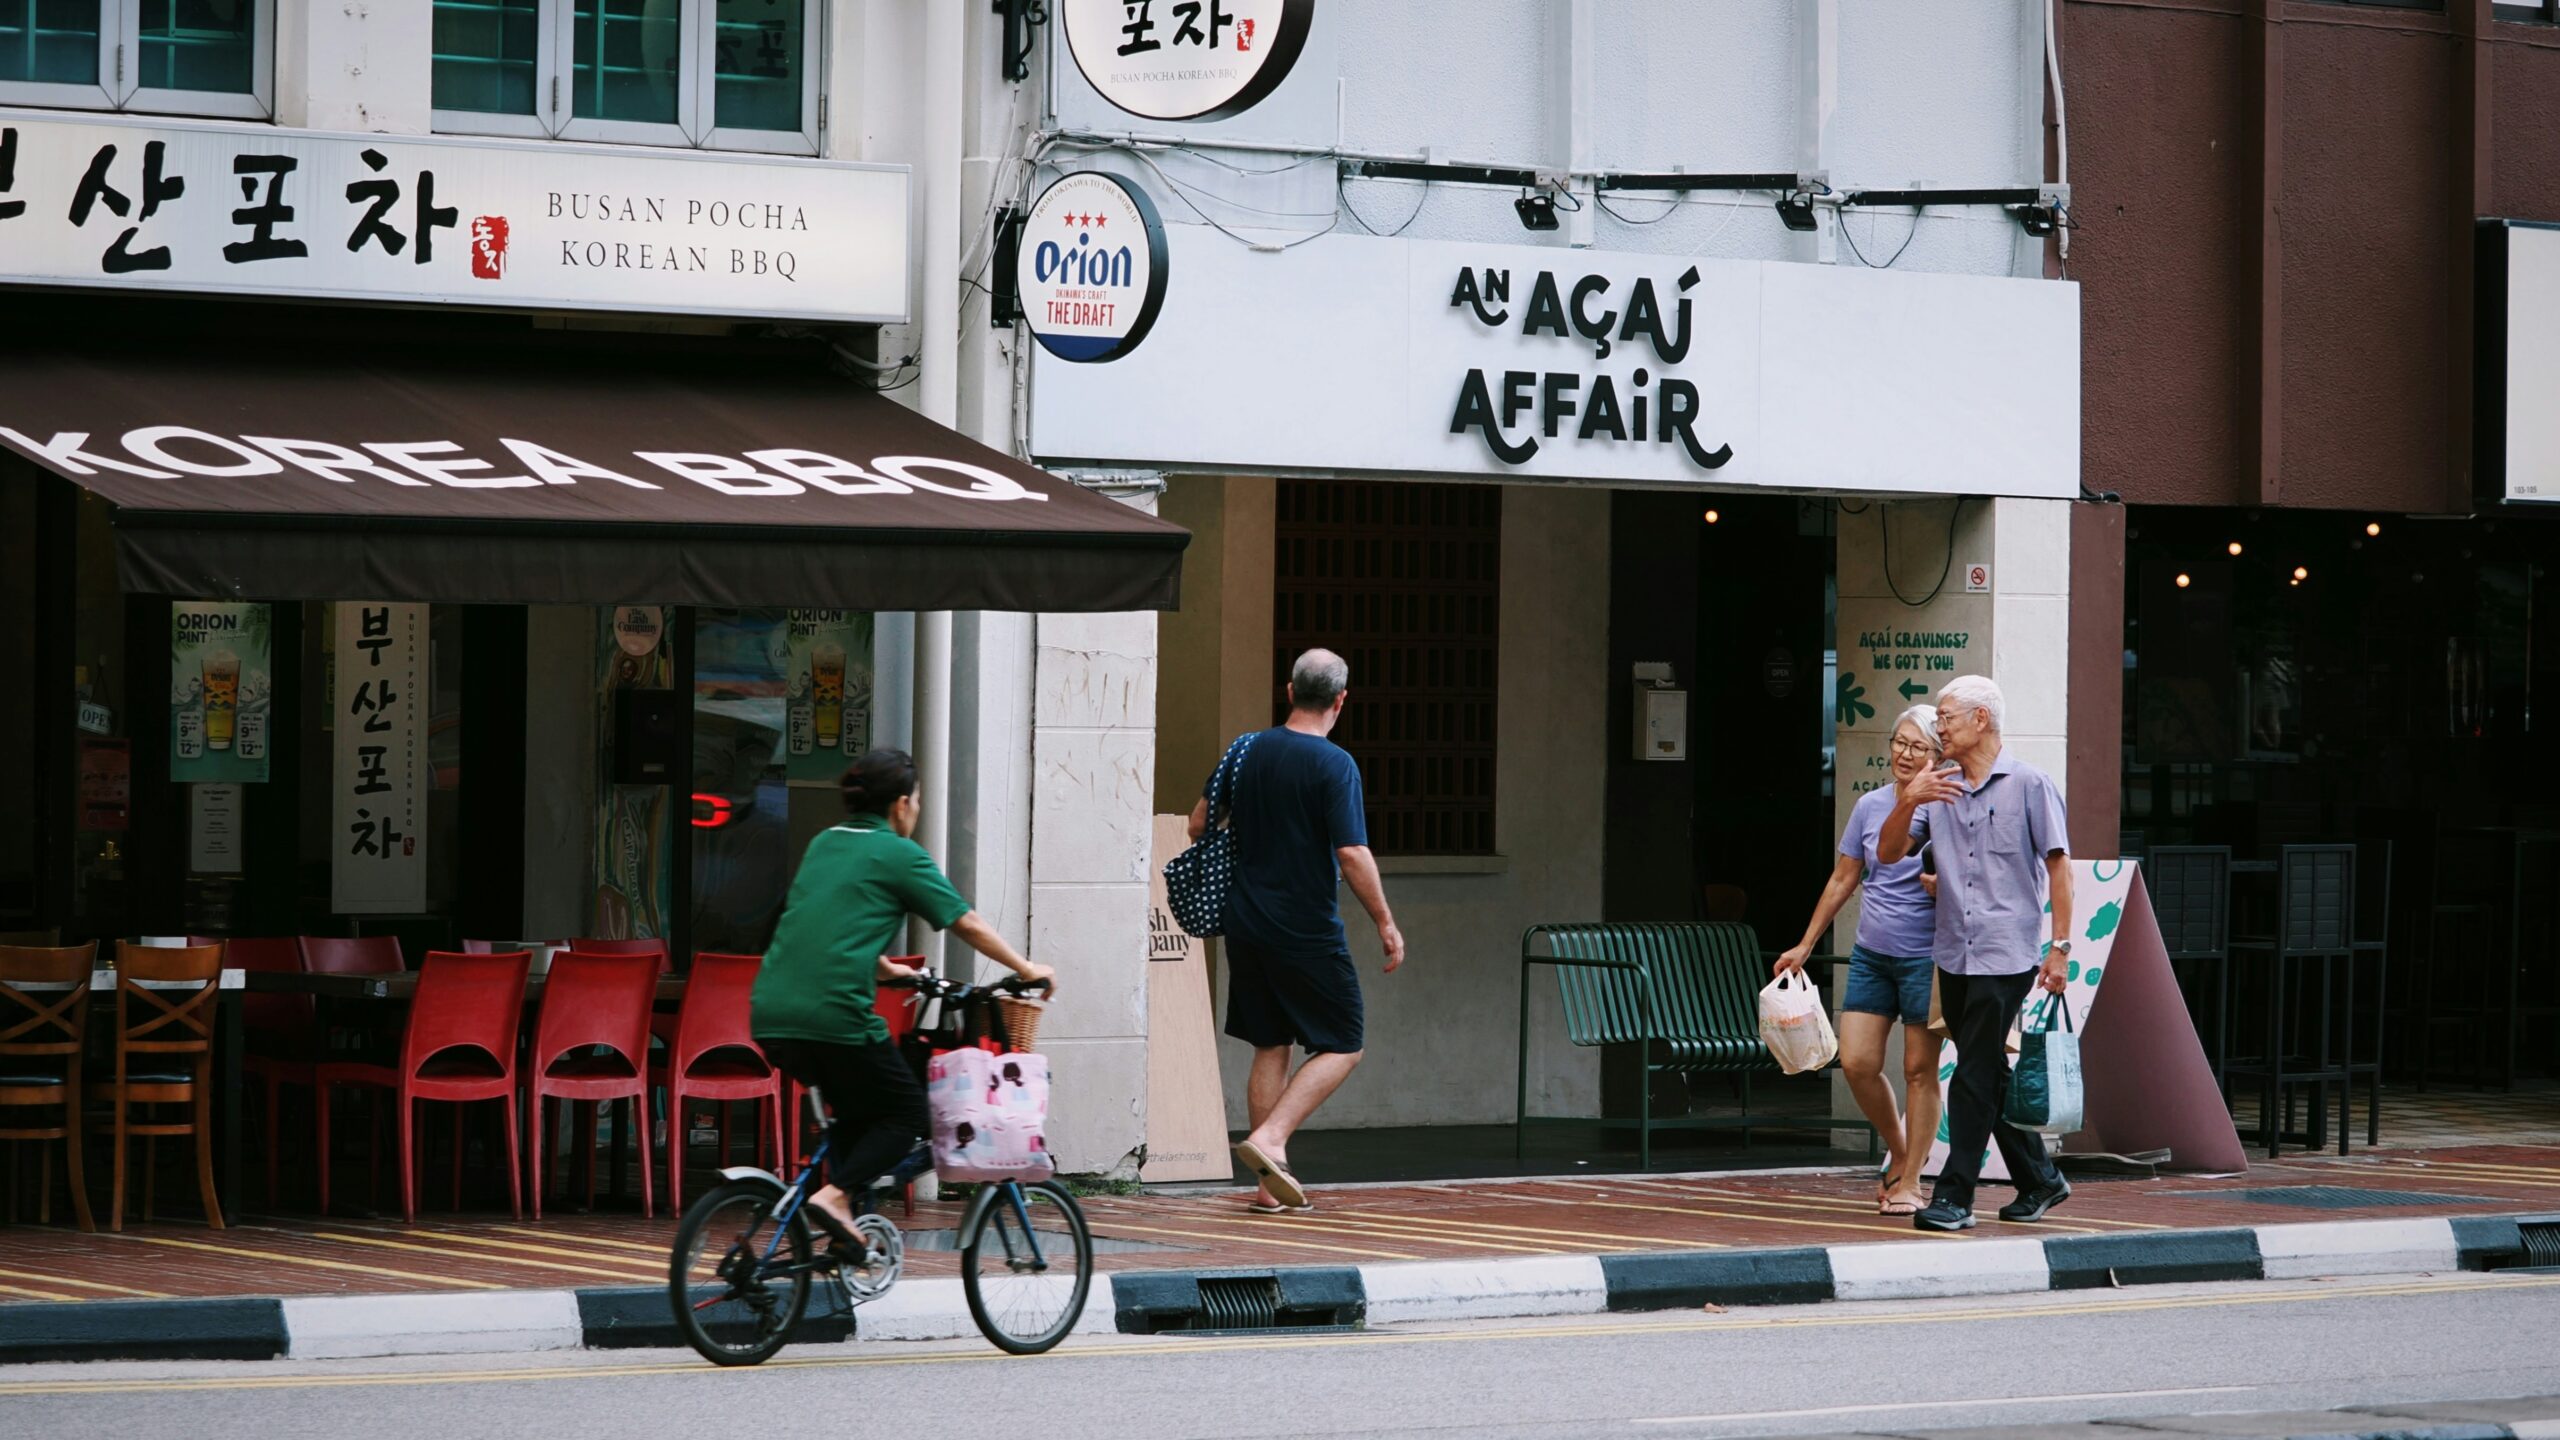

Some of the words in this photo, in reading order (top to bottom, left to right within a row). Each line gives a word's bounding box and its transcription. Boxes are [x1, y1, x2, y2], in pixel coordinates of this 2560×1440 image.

[1110, 73, 1141, 84] BUSAN
[1143, 71, 1175, 82] POCHA
[1177, 69, 1218, 81] KOREAN
[1218, 68, 1238, 79] BBQ
[548, 192, 665, 223] BUSAN
[687, 199, 808, 232] POCHA
[1035, 195, 1054, 219] FROM
[1054, 179, 1089, 199] OKINAWA
[1089, 179, 1101, 188] TO
[1101, 181, 1116, 197] THE
[1116, 193, 1139, 224] WORLD
[561, 240, 708, 273] KOREAN
[730, 248, 797, 283] BBQ
[1035, 232, 1132, 287] Orion
[1088, 290, 1107, 300] CRAFT
[1450, 266, 1510, 327] AN
[1047, 301, 1071, 324] THE
[1073, 302, 1115, 327] DRAFT
[0, 426, 664, 489] KOREA
[632, 449, 1049, 502] BBQ
[177, 613, 237, 630] ORION
[628, 613, 648, 624] Lash
[790, 608, 842, 622] ORION
[177, 631, 207, 643] PINT
[617, 620, 657, 635] Company
[790, 623, 816, 635] PINT
[1859, 625, 1892, 653] AÇAÍ
[1895, 632, 1969, 649] CRAVINGS?
[1873, 653, 1891, 670] WE
[1895, 654, 1920, 670] GOT
[1924, 655, 1954, 671] YOU!
[351, 607, 402, 860] 부산포차
[1866, 756, 1892, 771] AÇA
[1148, 907, 1168, 932] sh
[1148, 934, 1189, 957] pany
